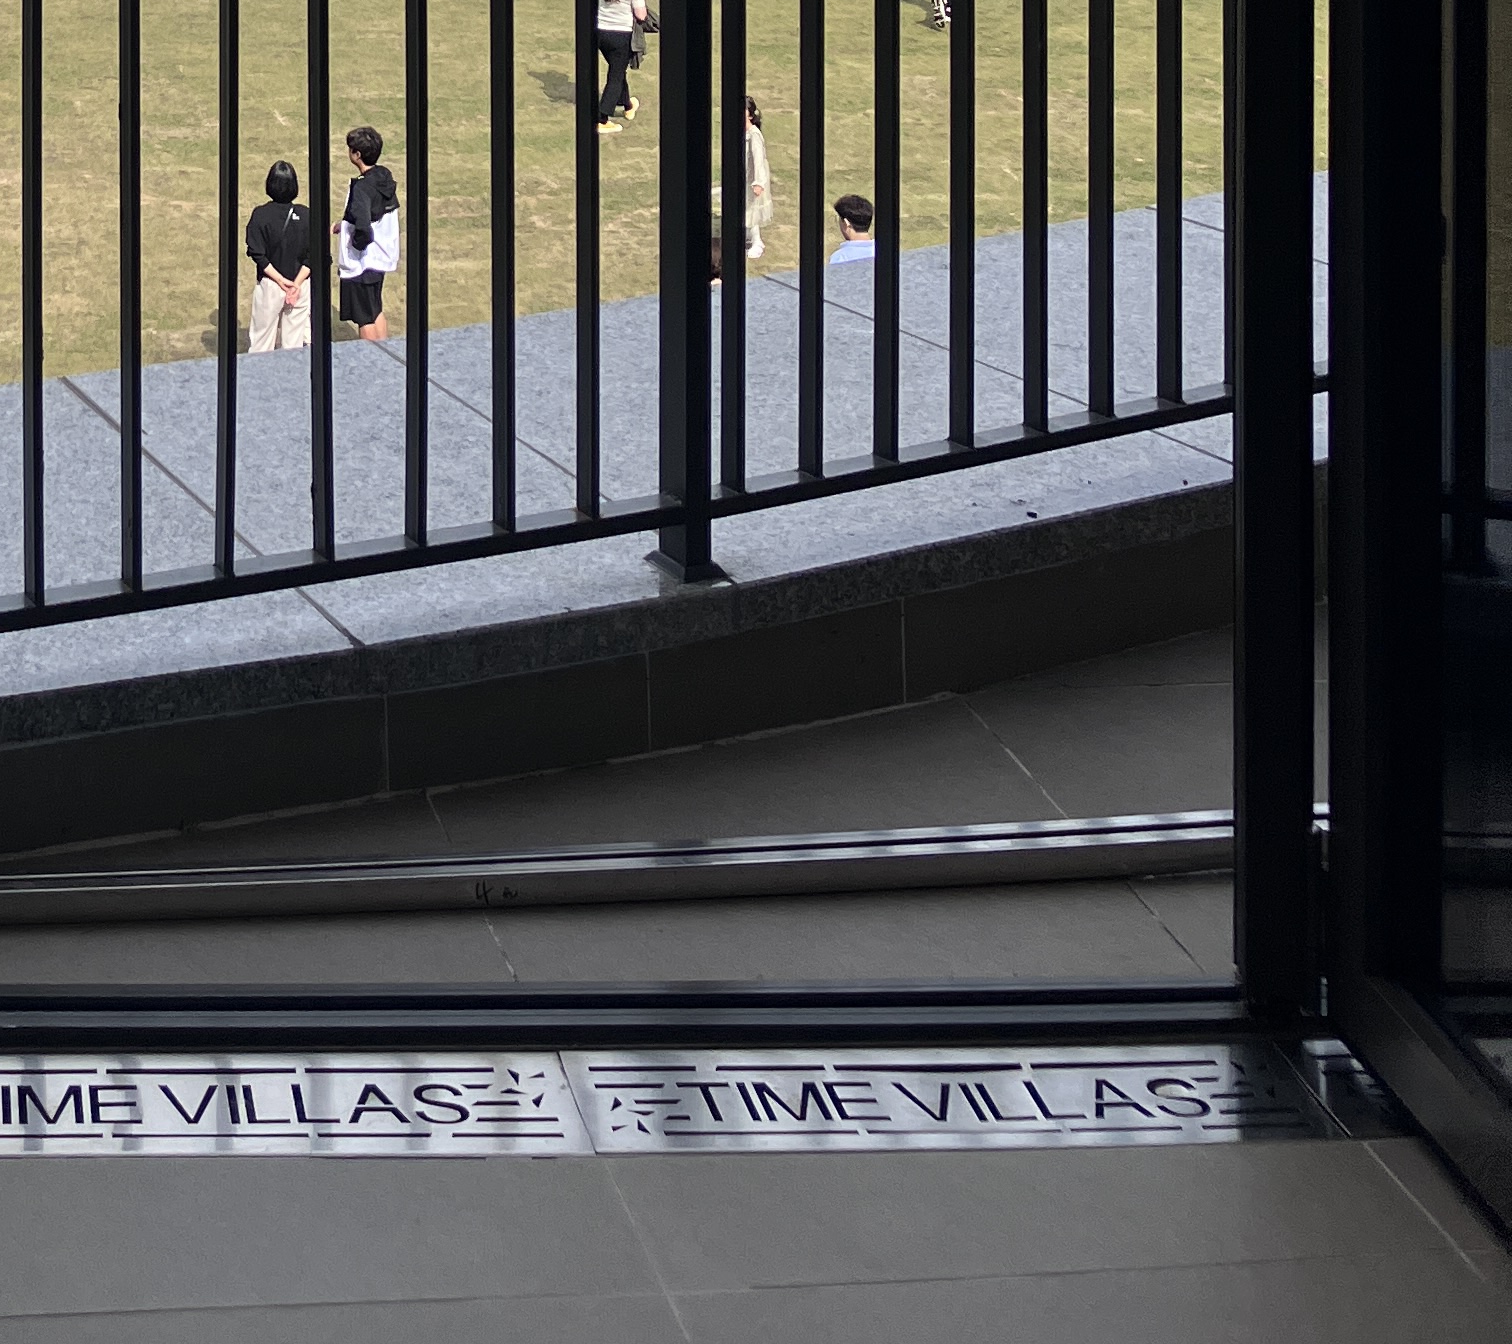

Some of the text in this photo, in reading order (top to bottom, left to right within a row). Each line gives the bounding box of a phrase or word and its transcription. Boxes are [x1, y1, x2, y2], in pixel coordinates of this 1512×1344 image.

[159, 1083, 472, 1125] VILLAS
[676, 1077, 1213, 1122] TIME VILLAS
